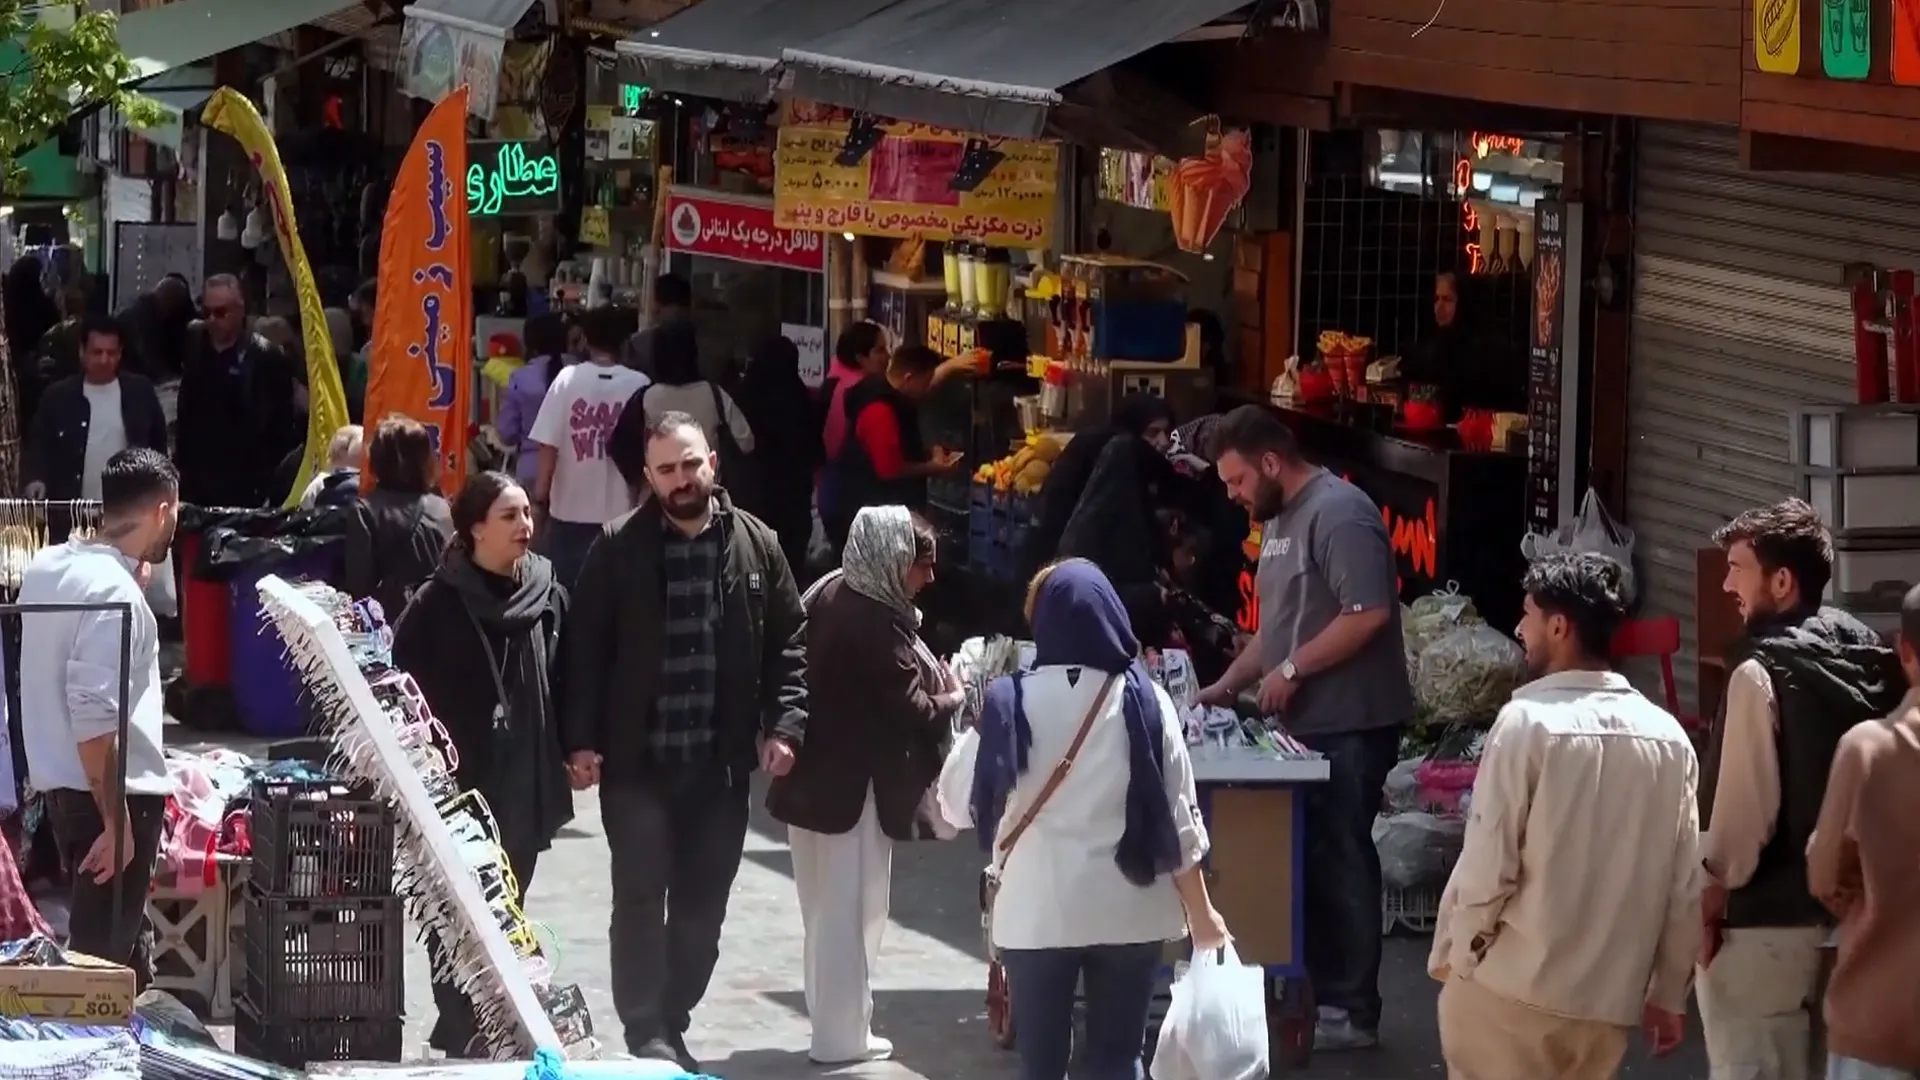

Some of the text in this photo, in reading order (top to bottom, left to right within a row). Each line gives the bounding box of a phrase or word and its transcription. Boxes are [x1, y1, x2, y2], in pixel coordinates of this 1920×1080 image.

[467, 142, 557, 214] عطاری
[424, 140, 454, 250] سیب
[815, 207, 824, 224] و
[827, 200, 861, 227] قارچ
[864, 206, 875, 228] با
[878, 209, 949, 232] مخصوص
[702, 216, 819, 254] فلافل درجه یک لبنانی
[1011, 217, 1043, 240] ذرت
[407, 263, 457, 410] زمینی
[85, 1001, 122, 1017] SOL
